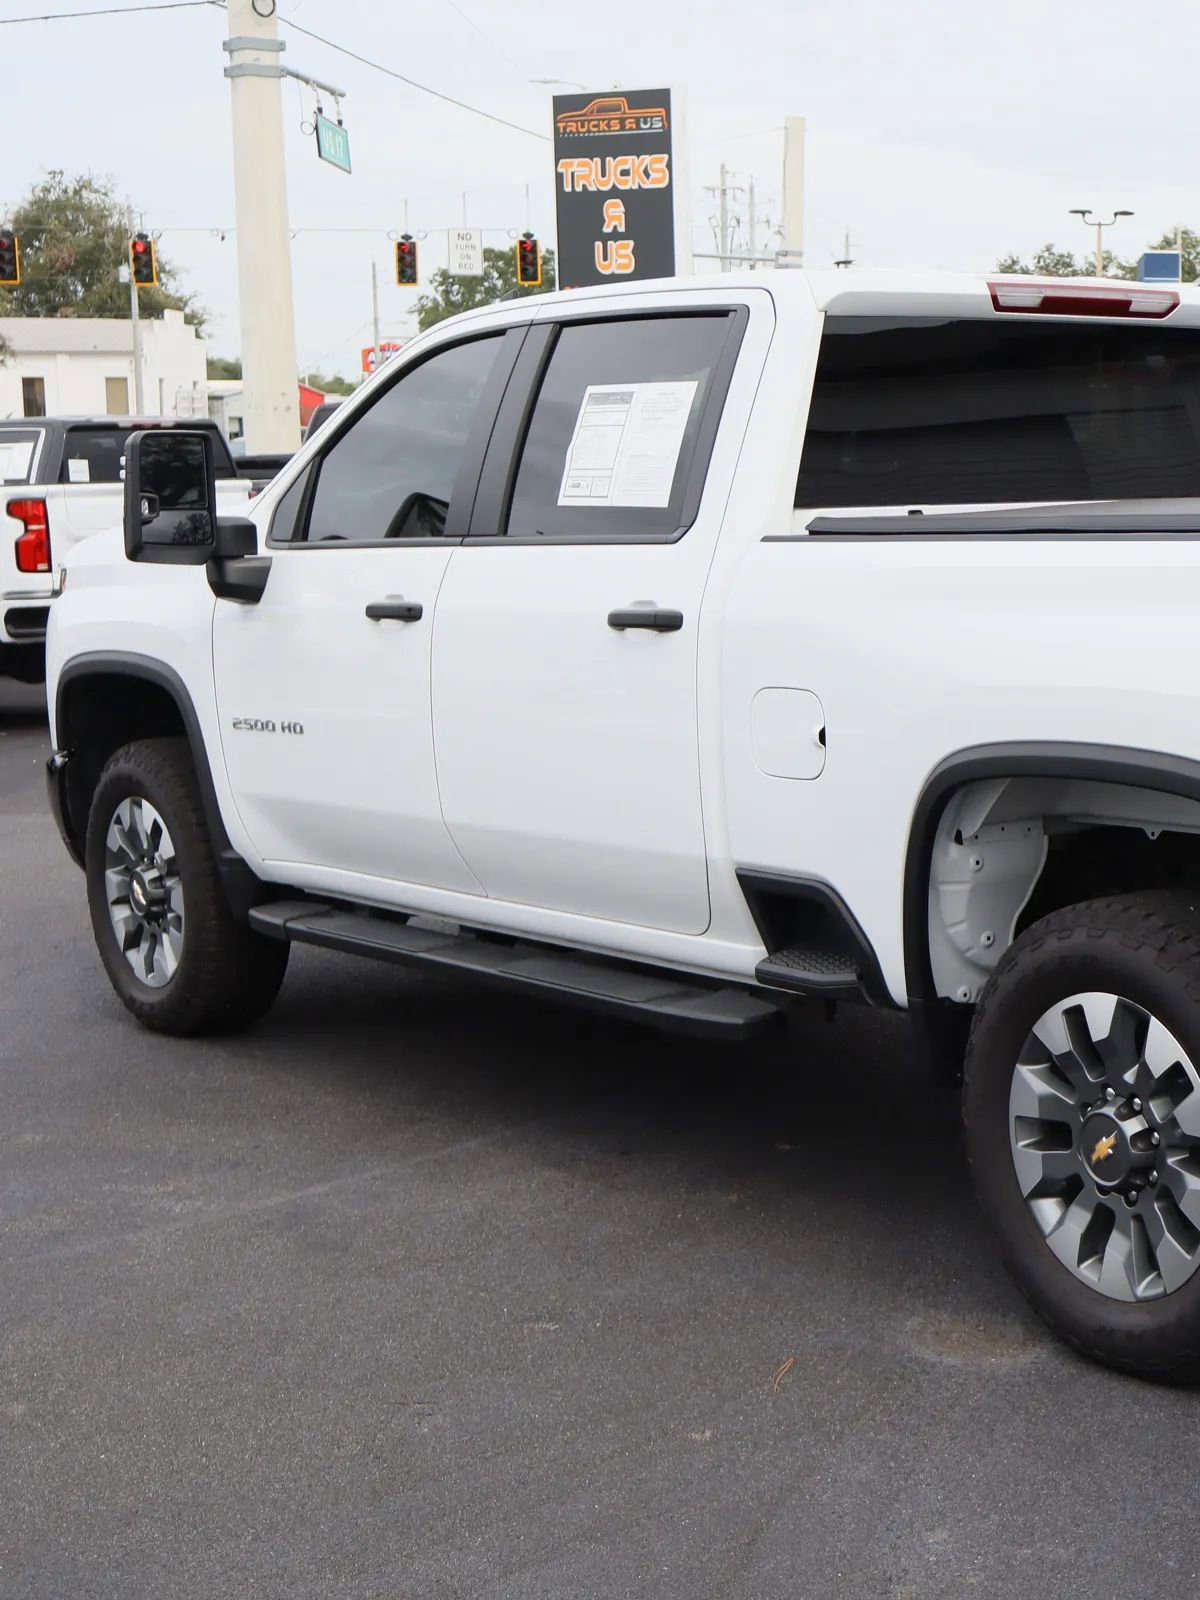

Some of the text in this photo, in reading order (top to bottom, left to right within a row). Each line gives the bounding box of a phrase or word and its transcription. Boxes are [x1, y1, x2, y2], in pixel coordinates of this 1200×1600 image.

[557, 119, 621, 133] TRUCKS
[640, 117, 663, 129] US
[322, 126, 335, 155] US
[557, 154, 669, 192] TRUCKS
[457, 232, 472, 241] NO
[594, 240, 635, 275] US
[232, 717, 304, 735] 2500 HD
